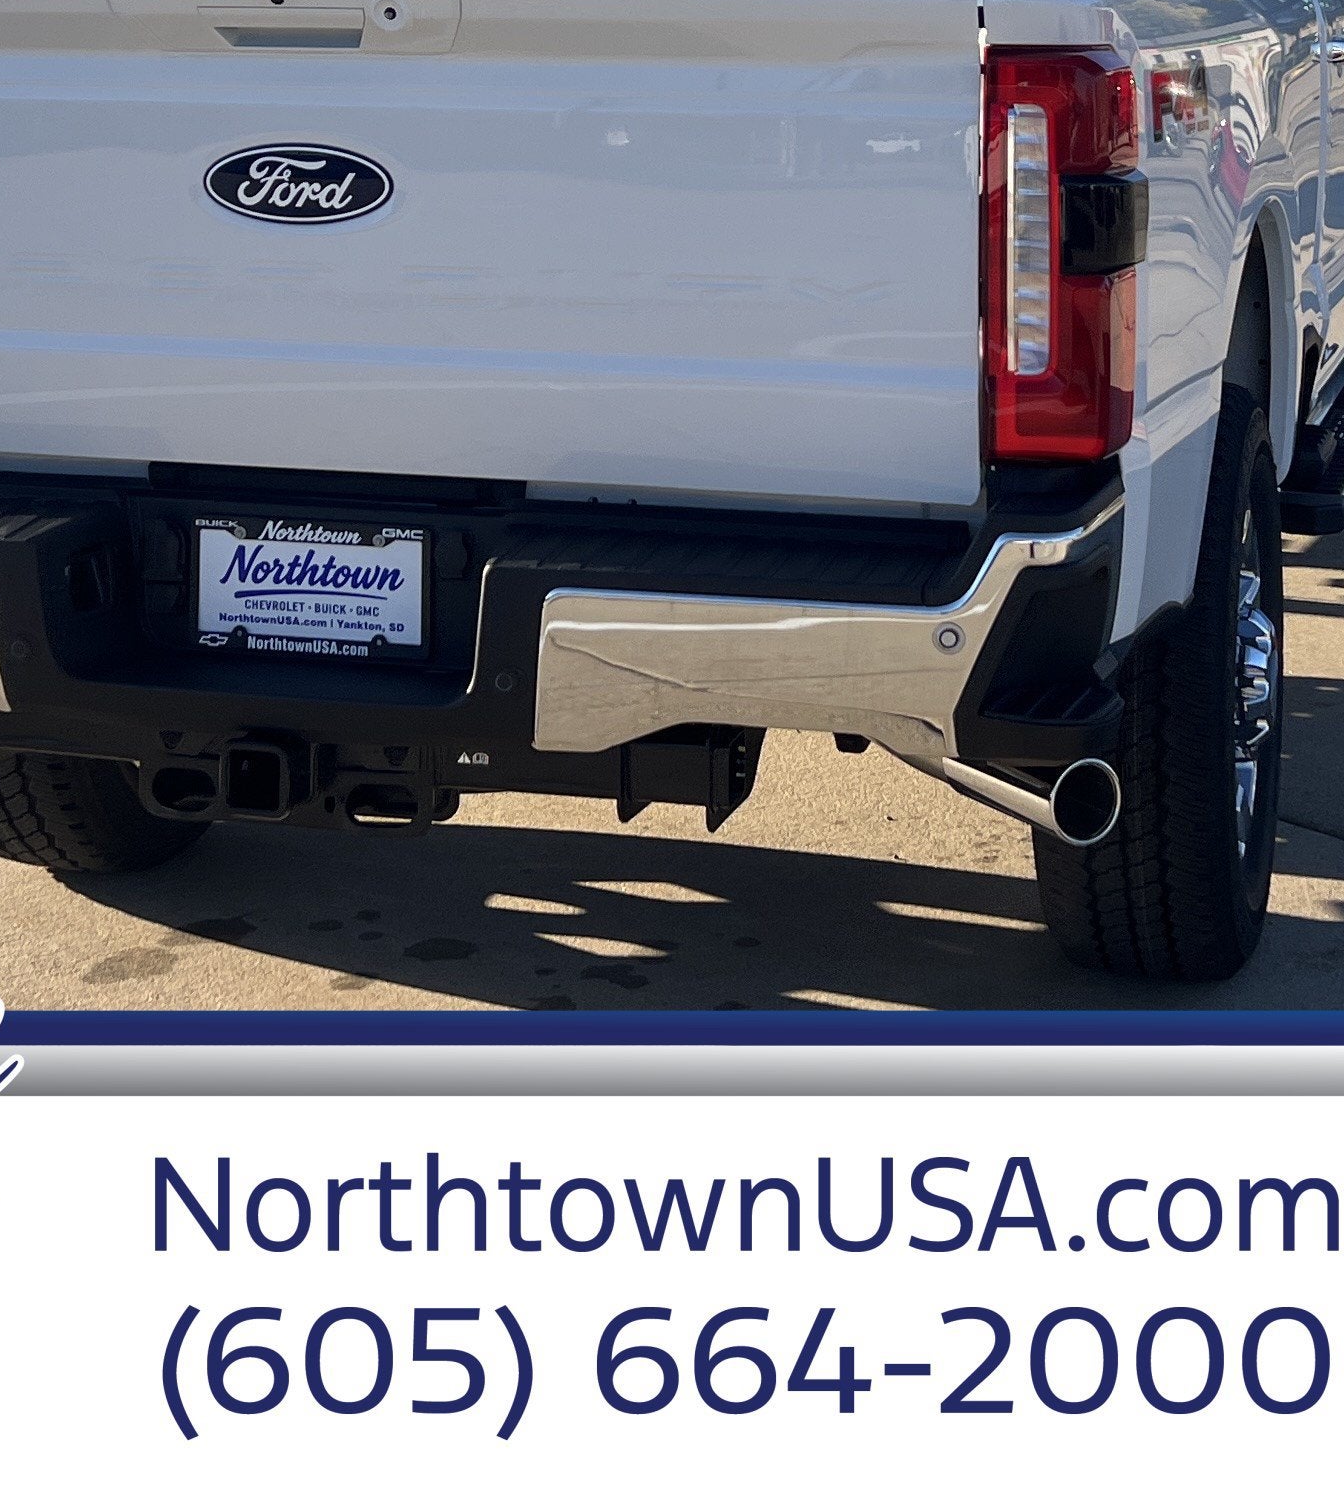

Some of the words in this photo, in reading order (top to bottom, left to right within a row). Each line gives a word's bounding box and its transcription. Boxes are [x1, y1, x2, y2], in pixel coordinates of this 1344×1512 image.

[237, 156, 356, 209] Ford
[195, 518, 239, 528] BUICK
[258, 520, 363, 545] Northtown
[382, 528, 424, 539] GMC
[219, 544, 405, 591] Northtown
[244, 599, 306, 613] CHEVROLET
[314, 603, 347, 616] BUICK
[356, 605, 380, 617] GMC
[219, 612, 327, 629] NorthtownUSA.com
[337, 619, 386, 633] Yankton,
[389, 622, 405, 633] SD
[247, 635, 369, 657] NorthtownUSA.com
